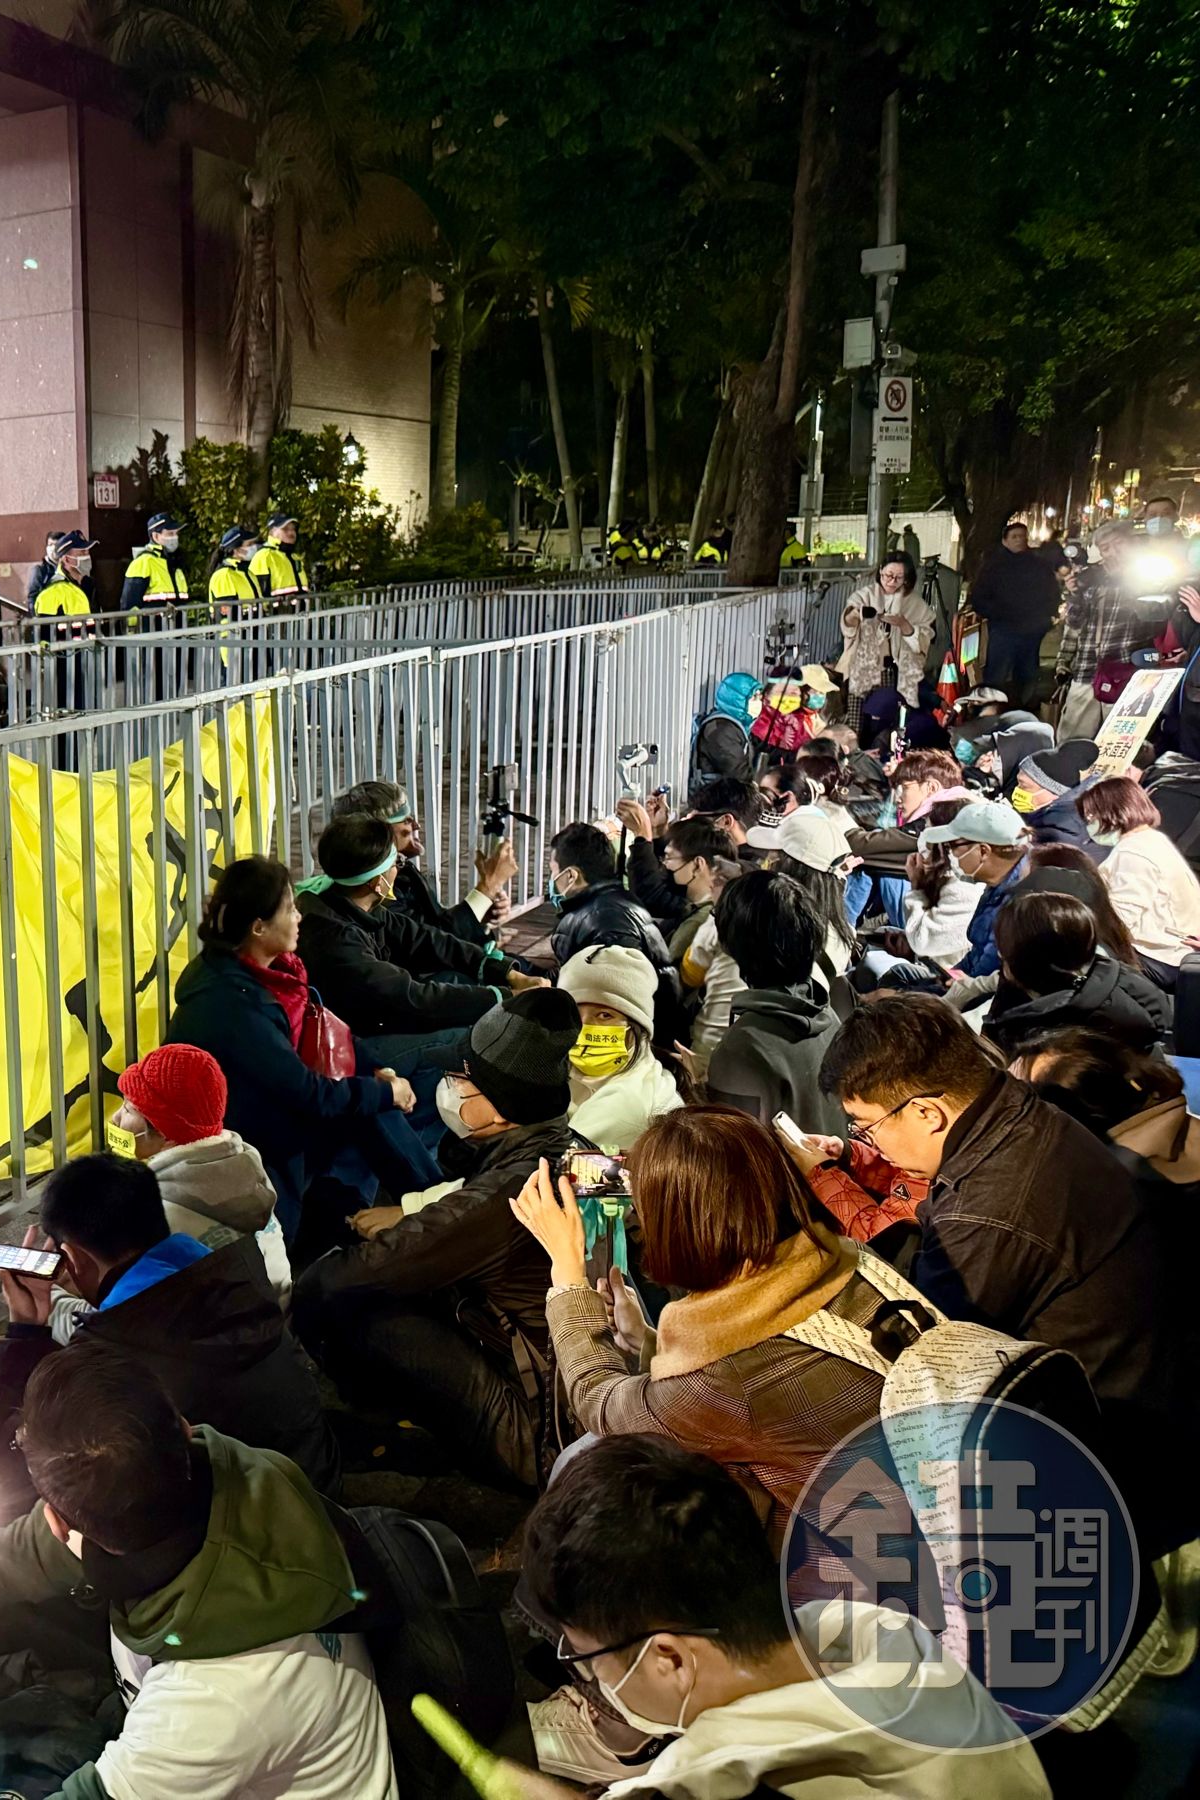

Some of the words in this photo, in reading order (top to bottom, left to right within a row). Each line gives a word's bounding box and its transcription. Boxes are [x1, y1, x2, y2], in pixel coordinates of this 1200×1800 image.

[99, 487, 116, 503] 131
[585, 1033, 619, 1043] 司法不公
